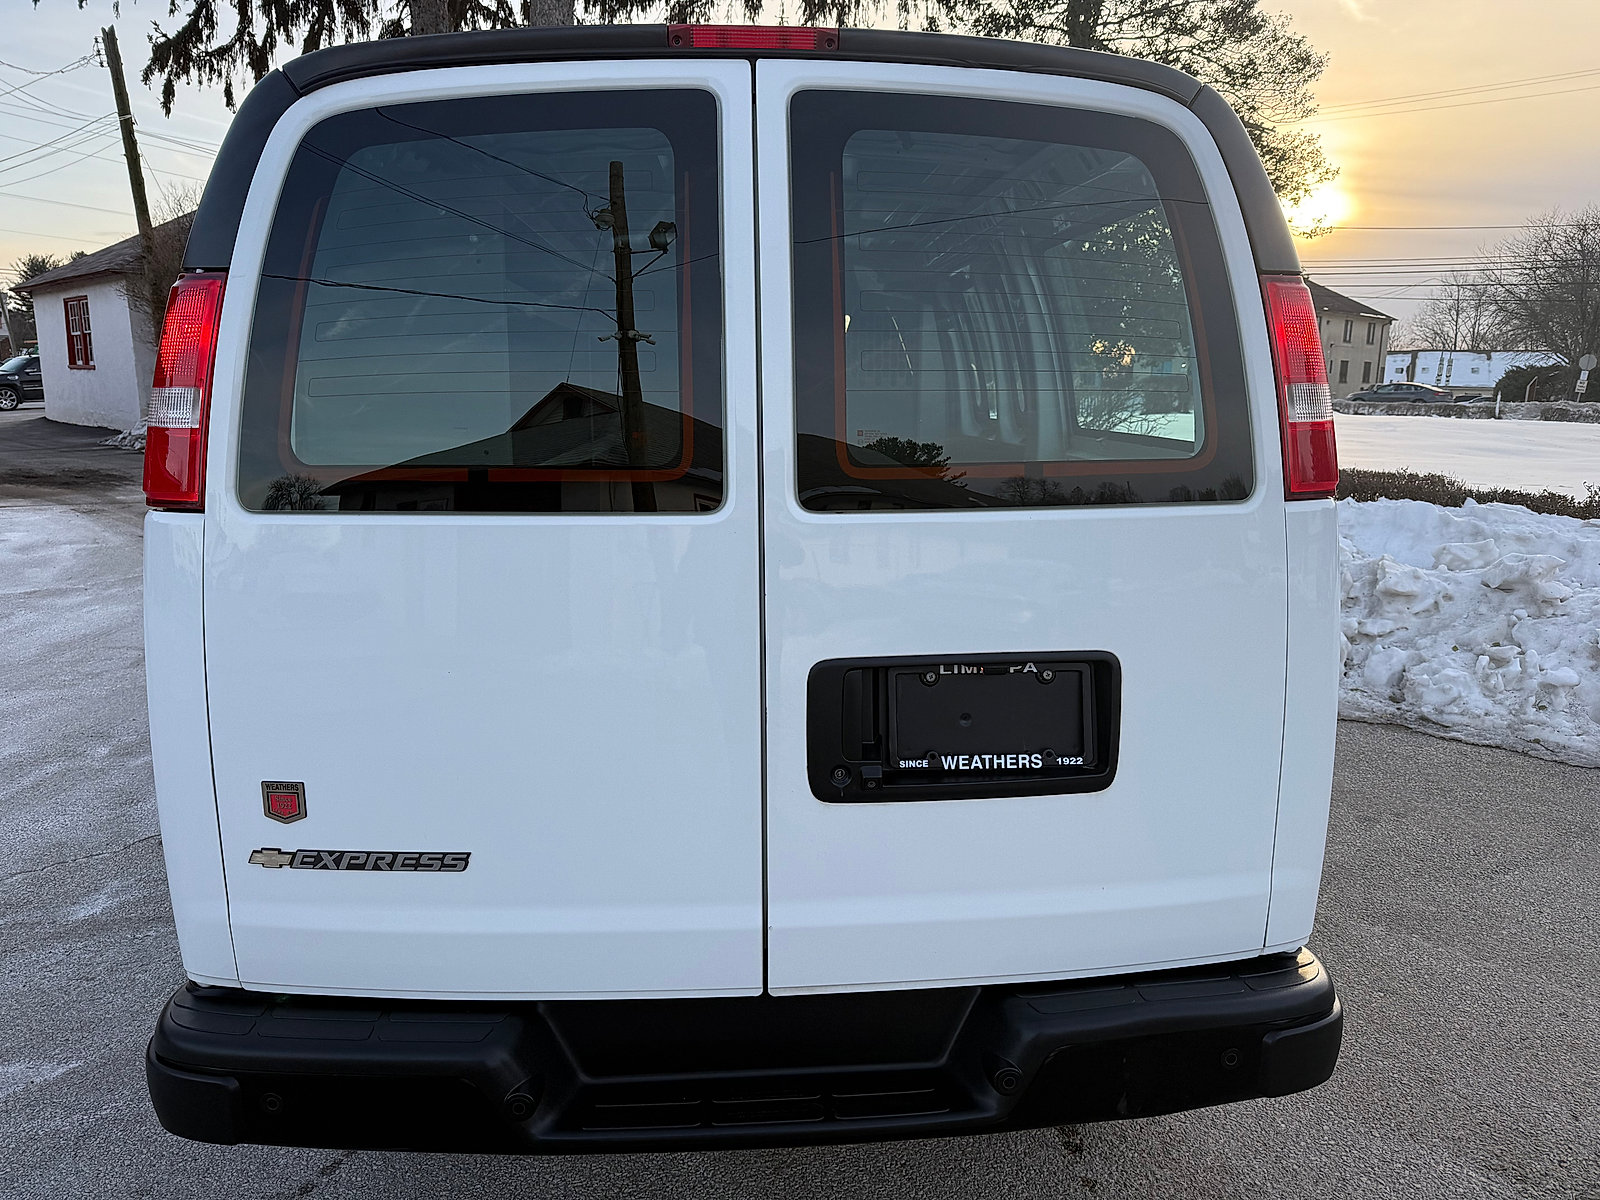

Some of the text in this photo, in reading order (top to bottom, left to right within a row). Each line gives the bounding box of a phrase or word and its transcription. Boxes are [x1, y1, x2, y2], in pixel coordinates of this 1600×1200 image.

[940, 664, 984, 675] LIM
[899, 754, 1084, 771] SINCE WEATHERS 1922
[265, 783, 299, 791] WEATHERS
[291, 851, 468, 871] EXPRESS
